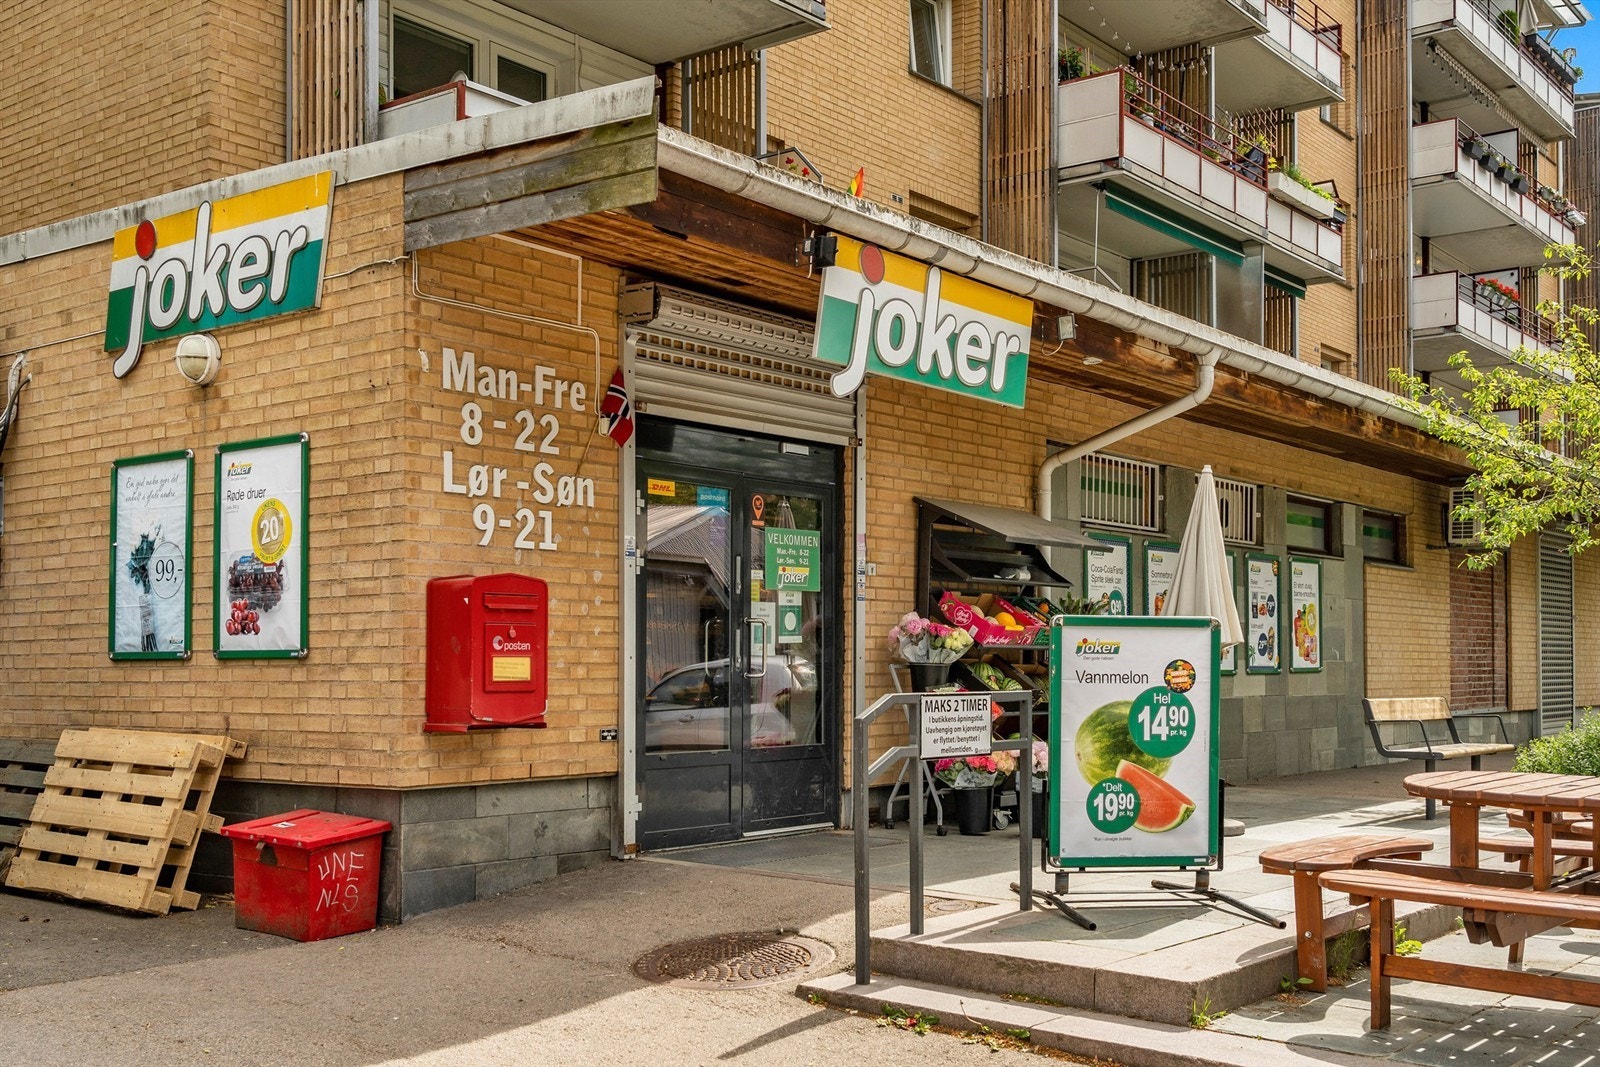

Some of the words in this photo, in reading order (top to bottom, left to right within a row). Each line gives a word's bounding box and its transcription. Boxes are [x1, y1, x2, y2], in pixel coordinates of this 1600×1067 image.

[113, 200, 308, 379] joker
[830, 243, 1021, 398] joker
[442, 347, 586, 411] Man-Fre
[246, 487, 267, 500] druer
[651, 484, 671, 492] DHL
[260, 516, 279, 545] 20
[472, 503, 557, 551] 9-21
[767, 533, 818, 547] VELKOMMEN
[777, 566, 808, 589] joker
[503, 641, 531, 652] posten
[1076, 638, 1118, 657] joker
[1075, 670, 1149, 684] Vannmelon
[924, 699, 952, 713] MAKS
[953, 700, 960, 712] 2
[961, 698, 988, 711] TIMER
[1153, 693, 1171, 704] Hel
[931, 715, 957, 724] butikkens
[957, 713, 985, 724] åpningstid.
[925, 725, 953, 735] Uavhengig
[962, 724, 988, 734] kjøretøyet
[1180, 729, 1187, 737] kg
[940, 745, 974, 754] mellomtiden.
[1126, 810, 1134, 818] kg
